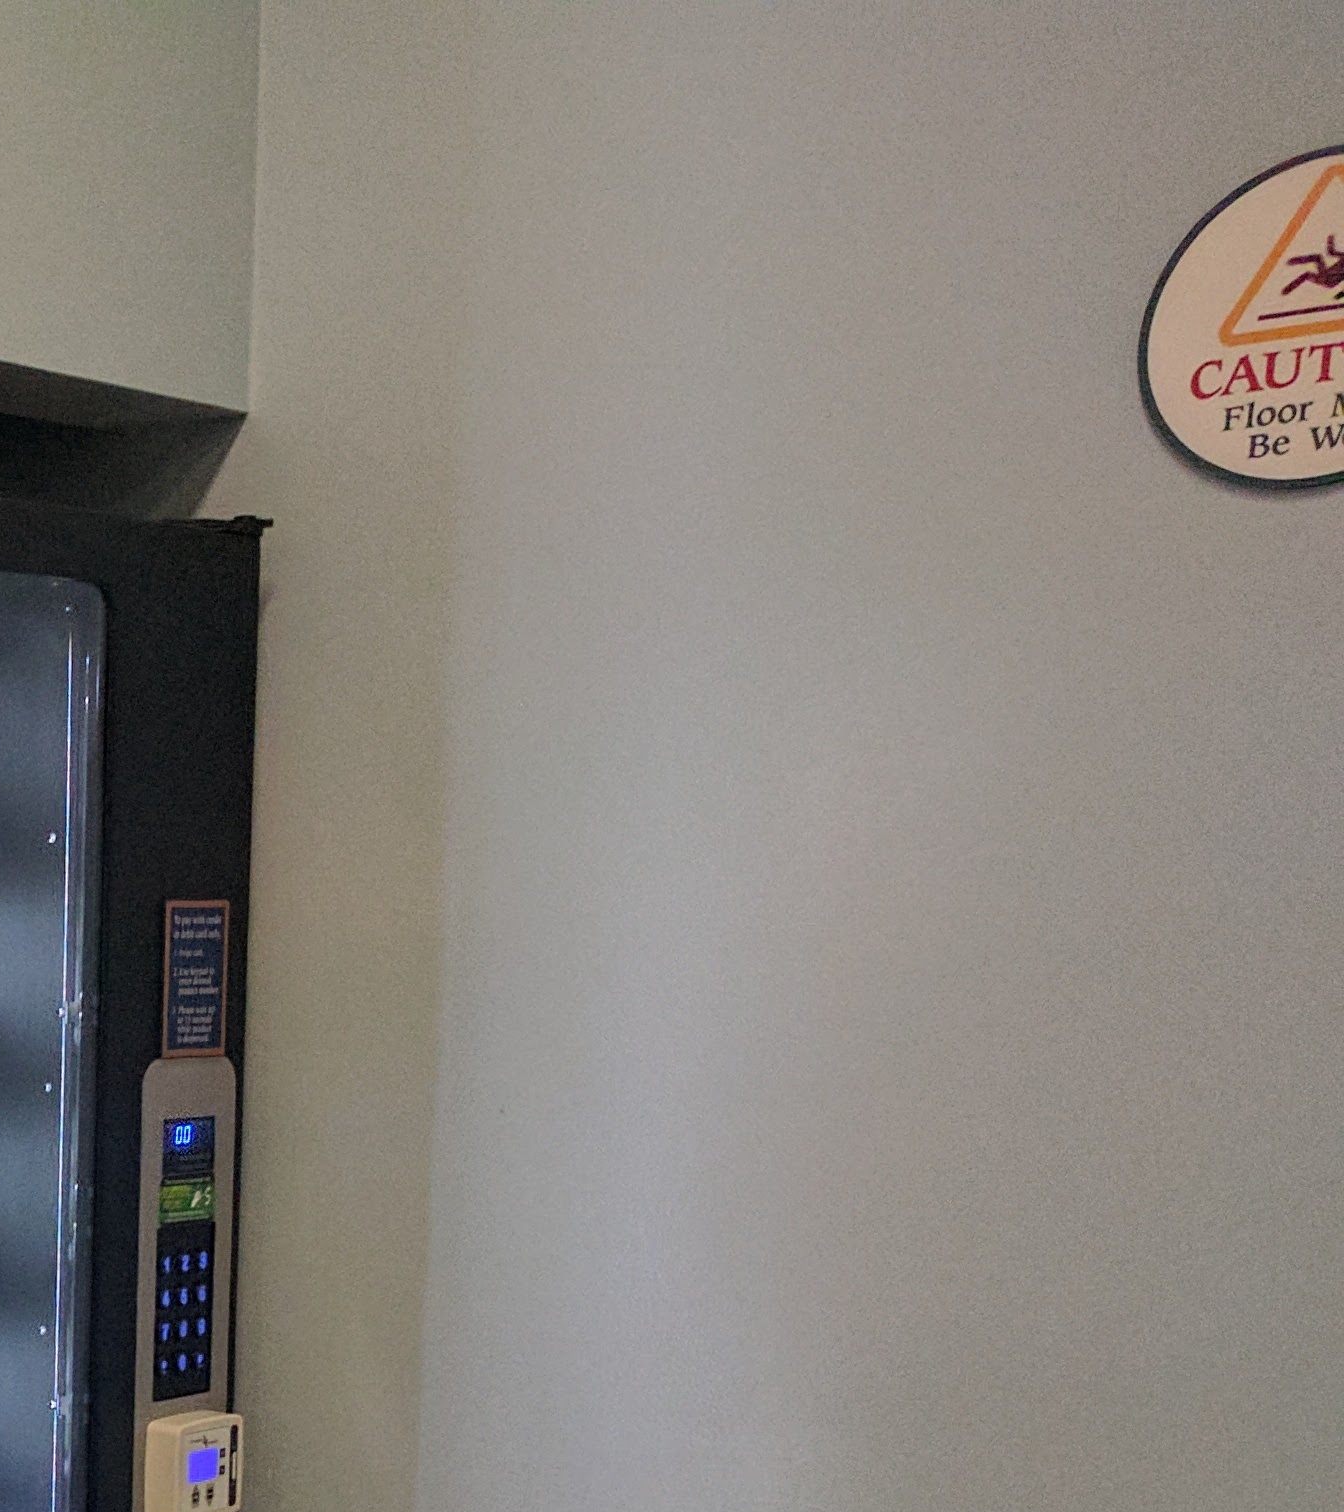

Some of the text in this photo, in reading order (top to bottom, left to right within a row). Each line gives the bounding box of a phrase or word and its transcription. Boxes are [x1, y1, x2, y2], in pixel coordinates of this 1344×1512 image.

[1190, 341, 1344, 400] CAUT
[1222, 401, 1313, 431] Floor
[1248, 433, 1290, 459] Be
[175, 1125, 192, 1145] 00
